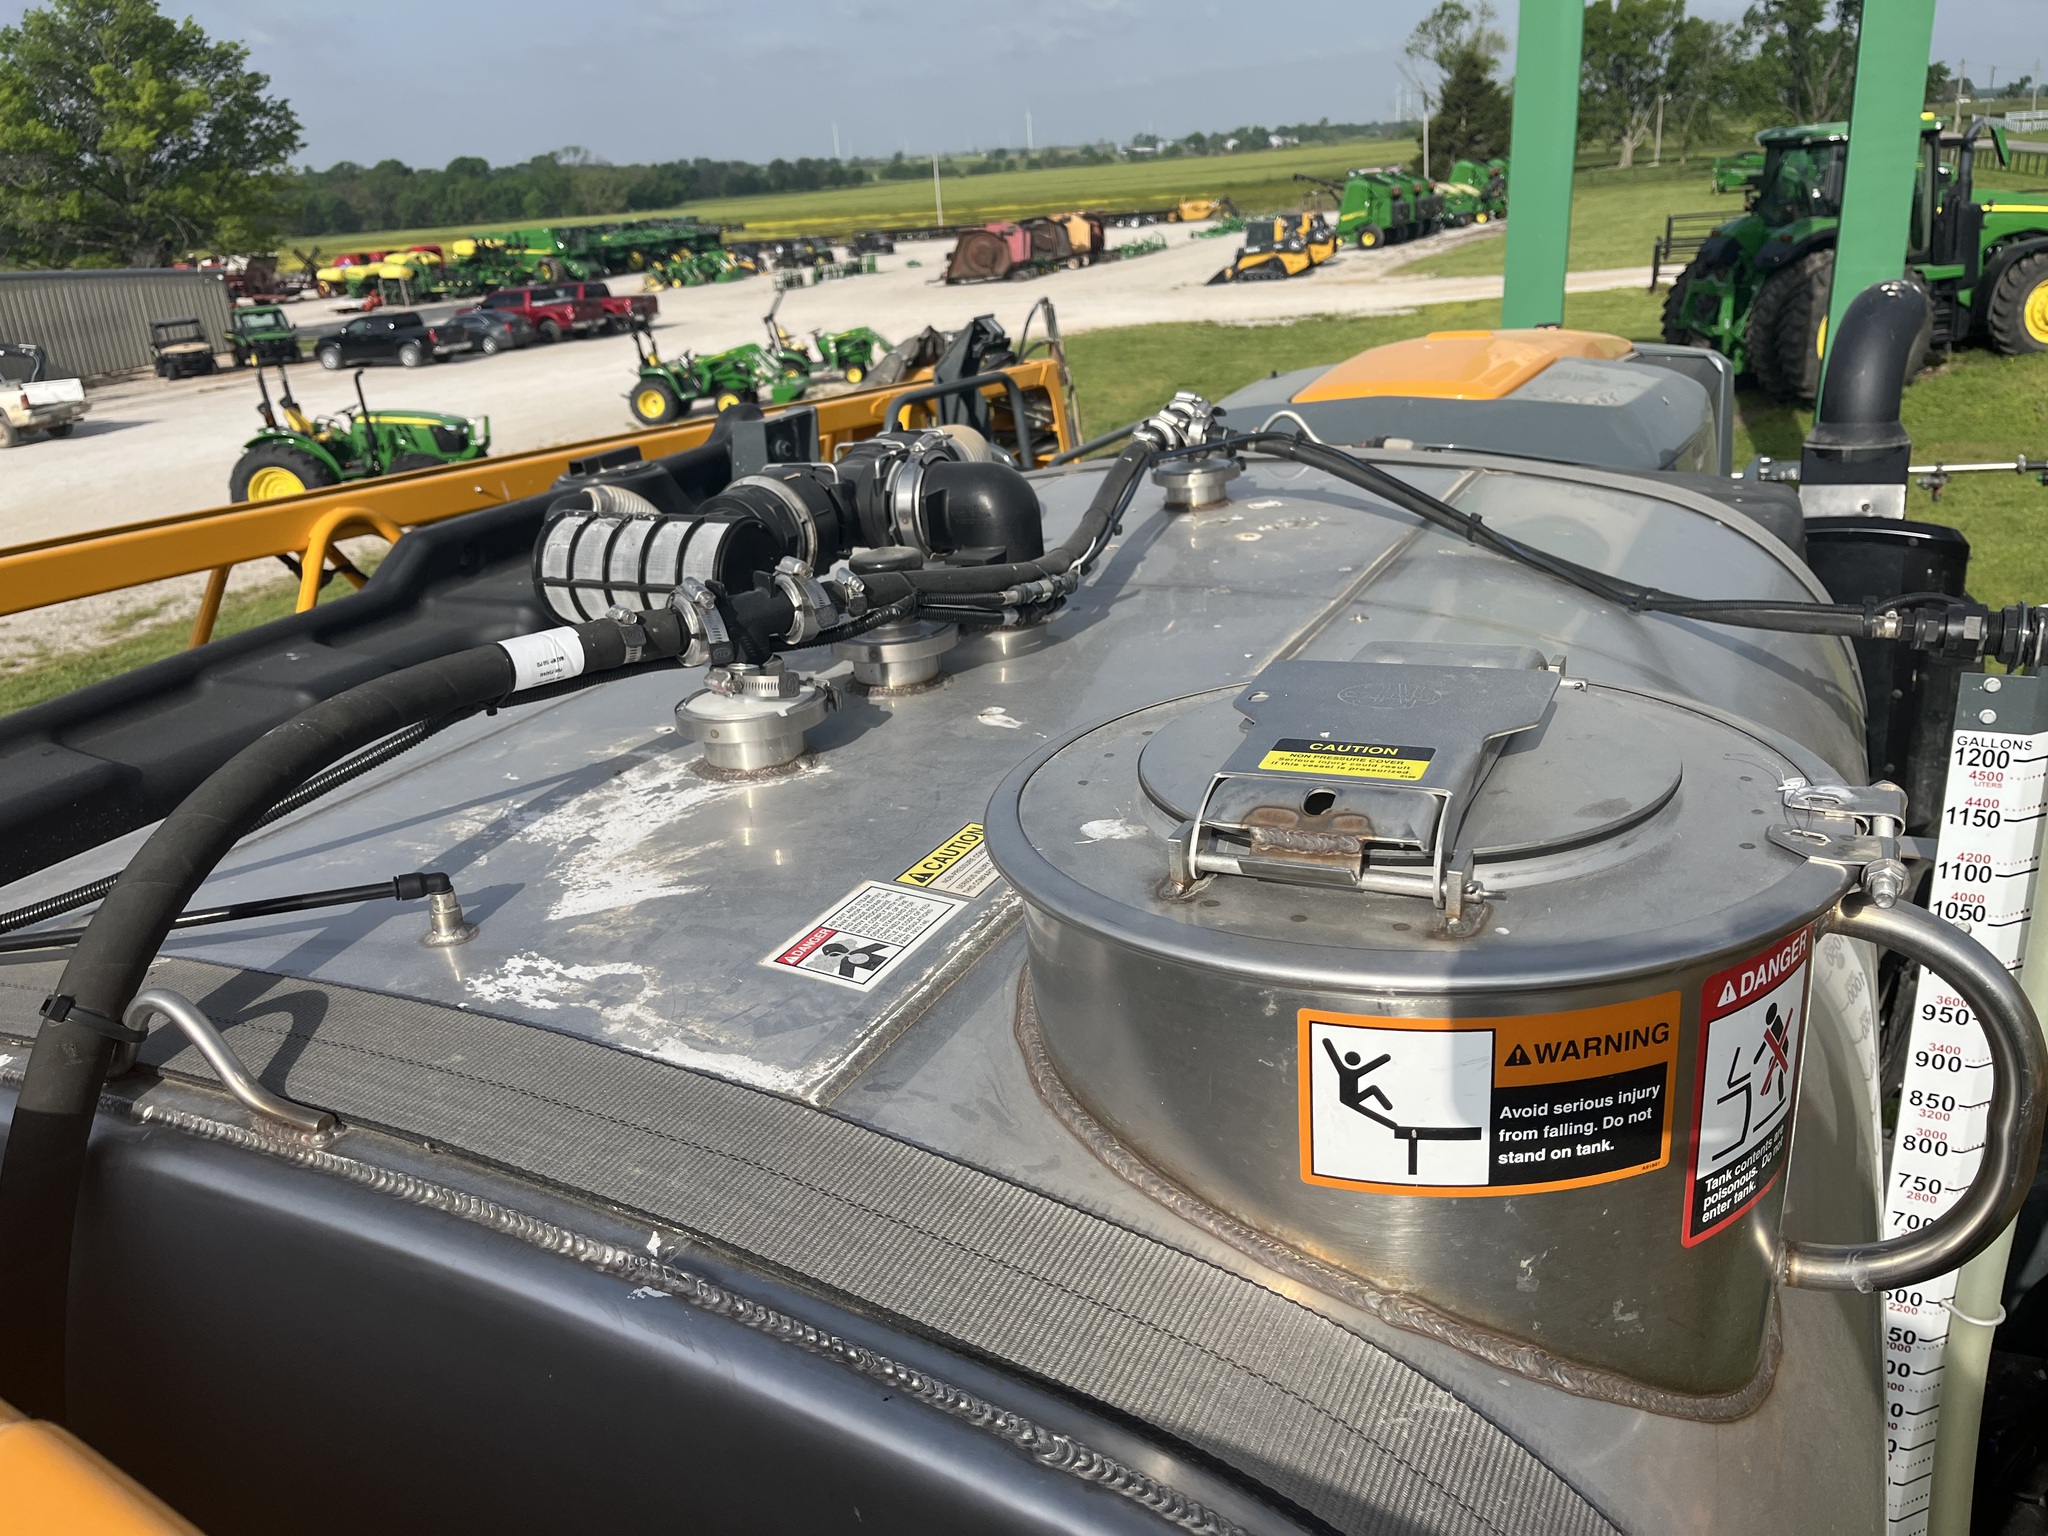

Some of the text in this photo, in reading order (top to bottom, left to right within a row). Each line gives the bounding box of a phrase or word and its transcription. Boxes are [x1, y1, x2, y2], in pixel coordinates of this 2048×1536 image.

[1310, 743, 1398, 755] CAUTION
[1957, 736, 2032, 750] GALLONS
[1955, 747, 2010, 769] 1200
[1969, 770, 2003, 782] 4500
[1965, 797, 1999, 808] 4400
[1947, 807, 2000, 828] 1150
[923, 827, 983, 870] CAUTION
[1957, 852, 1991, 864] 4200
[1939, 862, 1992, 883] 1100
[1951, 892, 1985, 903] 4000
[1934, 901, 1986, 922] 1050
[791, 928, 831, 958] DANGER
[1740, 929, 1808, 998] DANGER
[1936, 996, 1967, 1008] 3600
[1922, 1004, 1969, 1025] 950
[1535, 1023, 1669, 1064] WARNING
[1929, 1043, 1960, 1055] 3400
[1915, 1051, 1961, 1072] 900
[1500, 1085, 1660, 1119] Avoid serious injury
[1910, 1090, 1955, 1111] 850
[1499, 1107, 1652, 1141] from falling. Do not
[1919, 1108, 1950, 1121] 3200
[1916, 1128, 1947, 1140] 3000
[1498, 1139, 1614, 1164] stand on tank.
[1903, 1135, 1948, 1156] 800
[1705, 1124, 1784, 1192] Tank contents are
[1704, 1136, 1783, 1211] poisonous. Do not
[1899, 1172, 1941, 1194] 750
[1702, 1180, 1756, 1222] enter tank.
[1907, 1191, 1937, 1203] 2800
[1889, 1302, 1918, 1315] 2200
[1888, 1327, 1916, 1345] 50
[1887, 1360, 1910, 1377] 00
